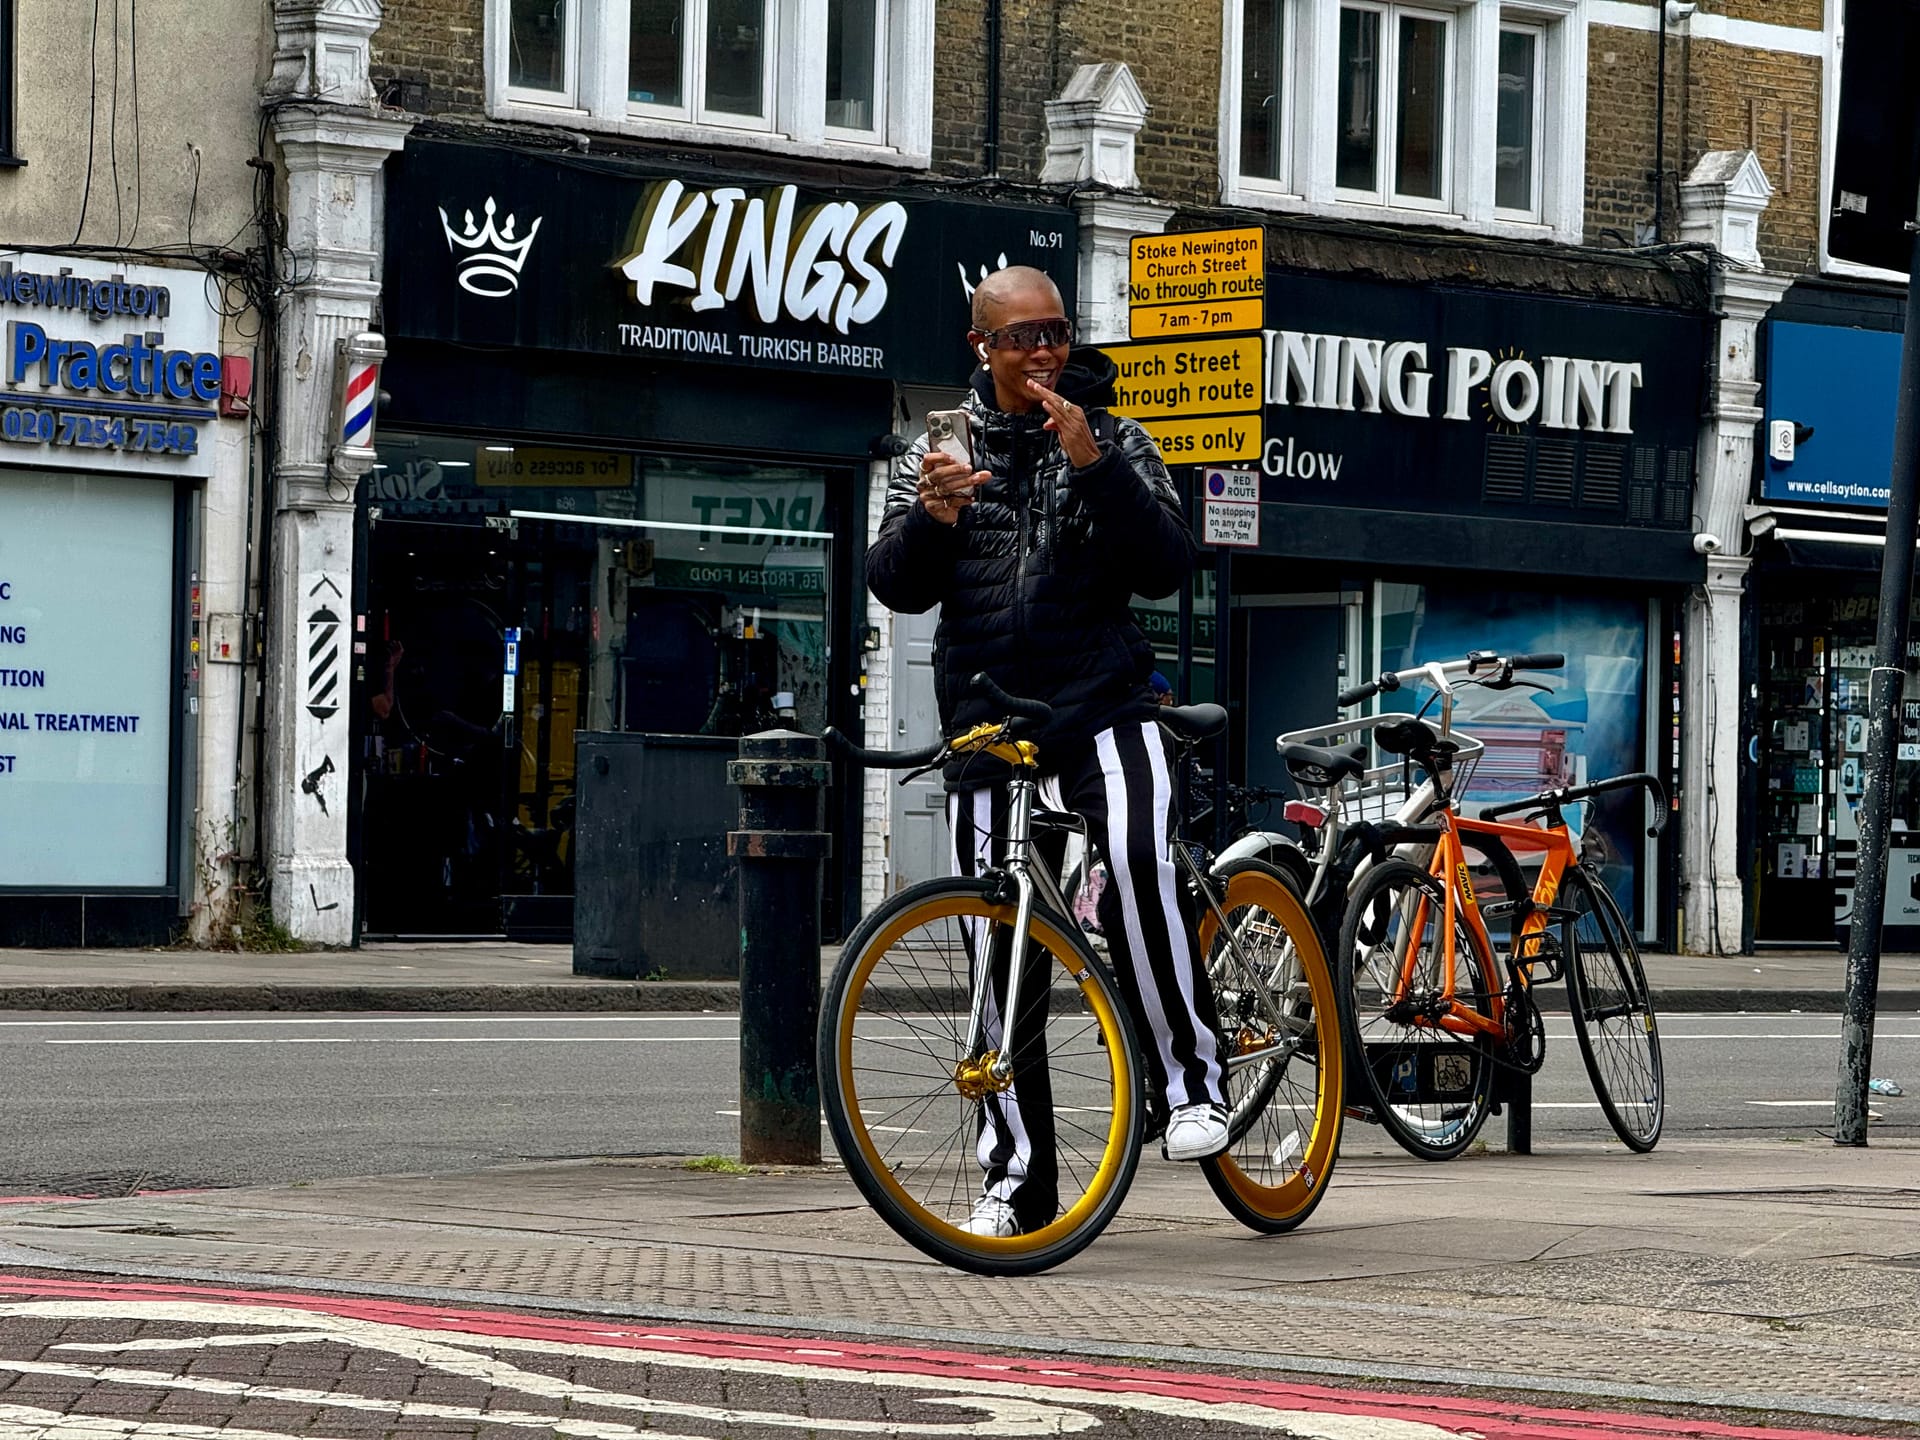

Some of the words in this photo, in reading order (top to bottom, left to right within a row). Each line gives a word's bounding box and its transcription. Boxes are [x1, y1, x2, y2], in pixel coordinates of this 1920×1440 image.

[1029, 230, 1064, 249] No.91
[1136, 243, 1177, 260] Stoke
[1182, 237, 1258, 256] Newington
[622, 179, 908, 334] KINGS
[1146, 260, 1197, 278] Church
[1202, 256, 1247, 273] Street
[1129, 284, 1150, 301] No
[1156, 278, 1217, 299] through
[1222, 275, 1264, 294] route
[618, 323, 733, 355] TRADITIONAL
[739, 334, 811, 363] TURKISH
[817, 343, 884, 369] BARBER
[7, 320, 222, 401] Practice
[1113, 355, 1166, 379] urch
[1174, 349, 1240, 375] Street
[1199, 378, 1254, 402] route
[1262, 329, 1434, 418] NING
[1442, 347, 1643, 434] POINT
[3, 407, 54, 443] 020
[60, 411, 127, 450] 7254
[126, 420, 199, 455] 7542
[1154, 434, 1195, 452] cess
[1202, 427, 1246, 452] only
[1261, 437, 1343, 481] Glow
[1227, 487, 1256, 498] ROUTE
[1233, 475, 1251, 486] RED
[1208, 505, 1220, 516] No
[1222, 506, 1256, 519] stopping
[1209, 518, 1220, 527] on
[1221, 519, 1236, 529] any
[1238, 518, 1252, 530] day
[1214, 529, 1249, 540] 7am-7pm
[35, 714, 140, 733] TREATMENT
[1457, 864, 1474, 902] MAVIC
[1420, 1101, 1478, 1146] ELLIPSE
